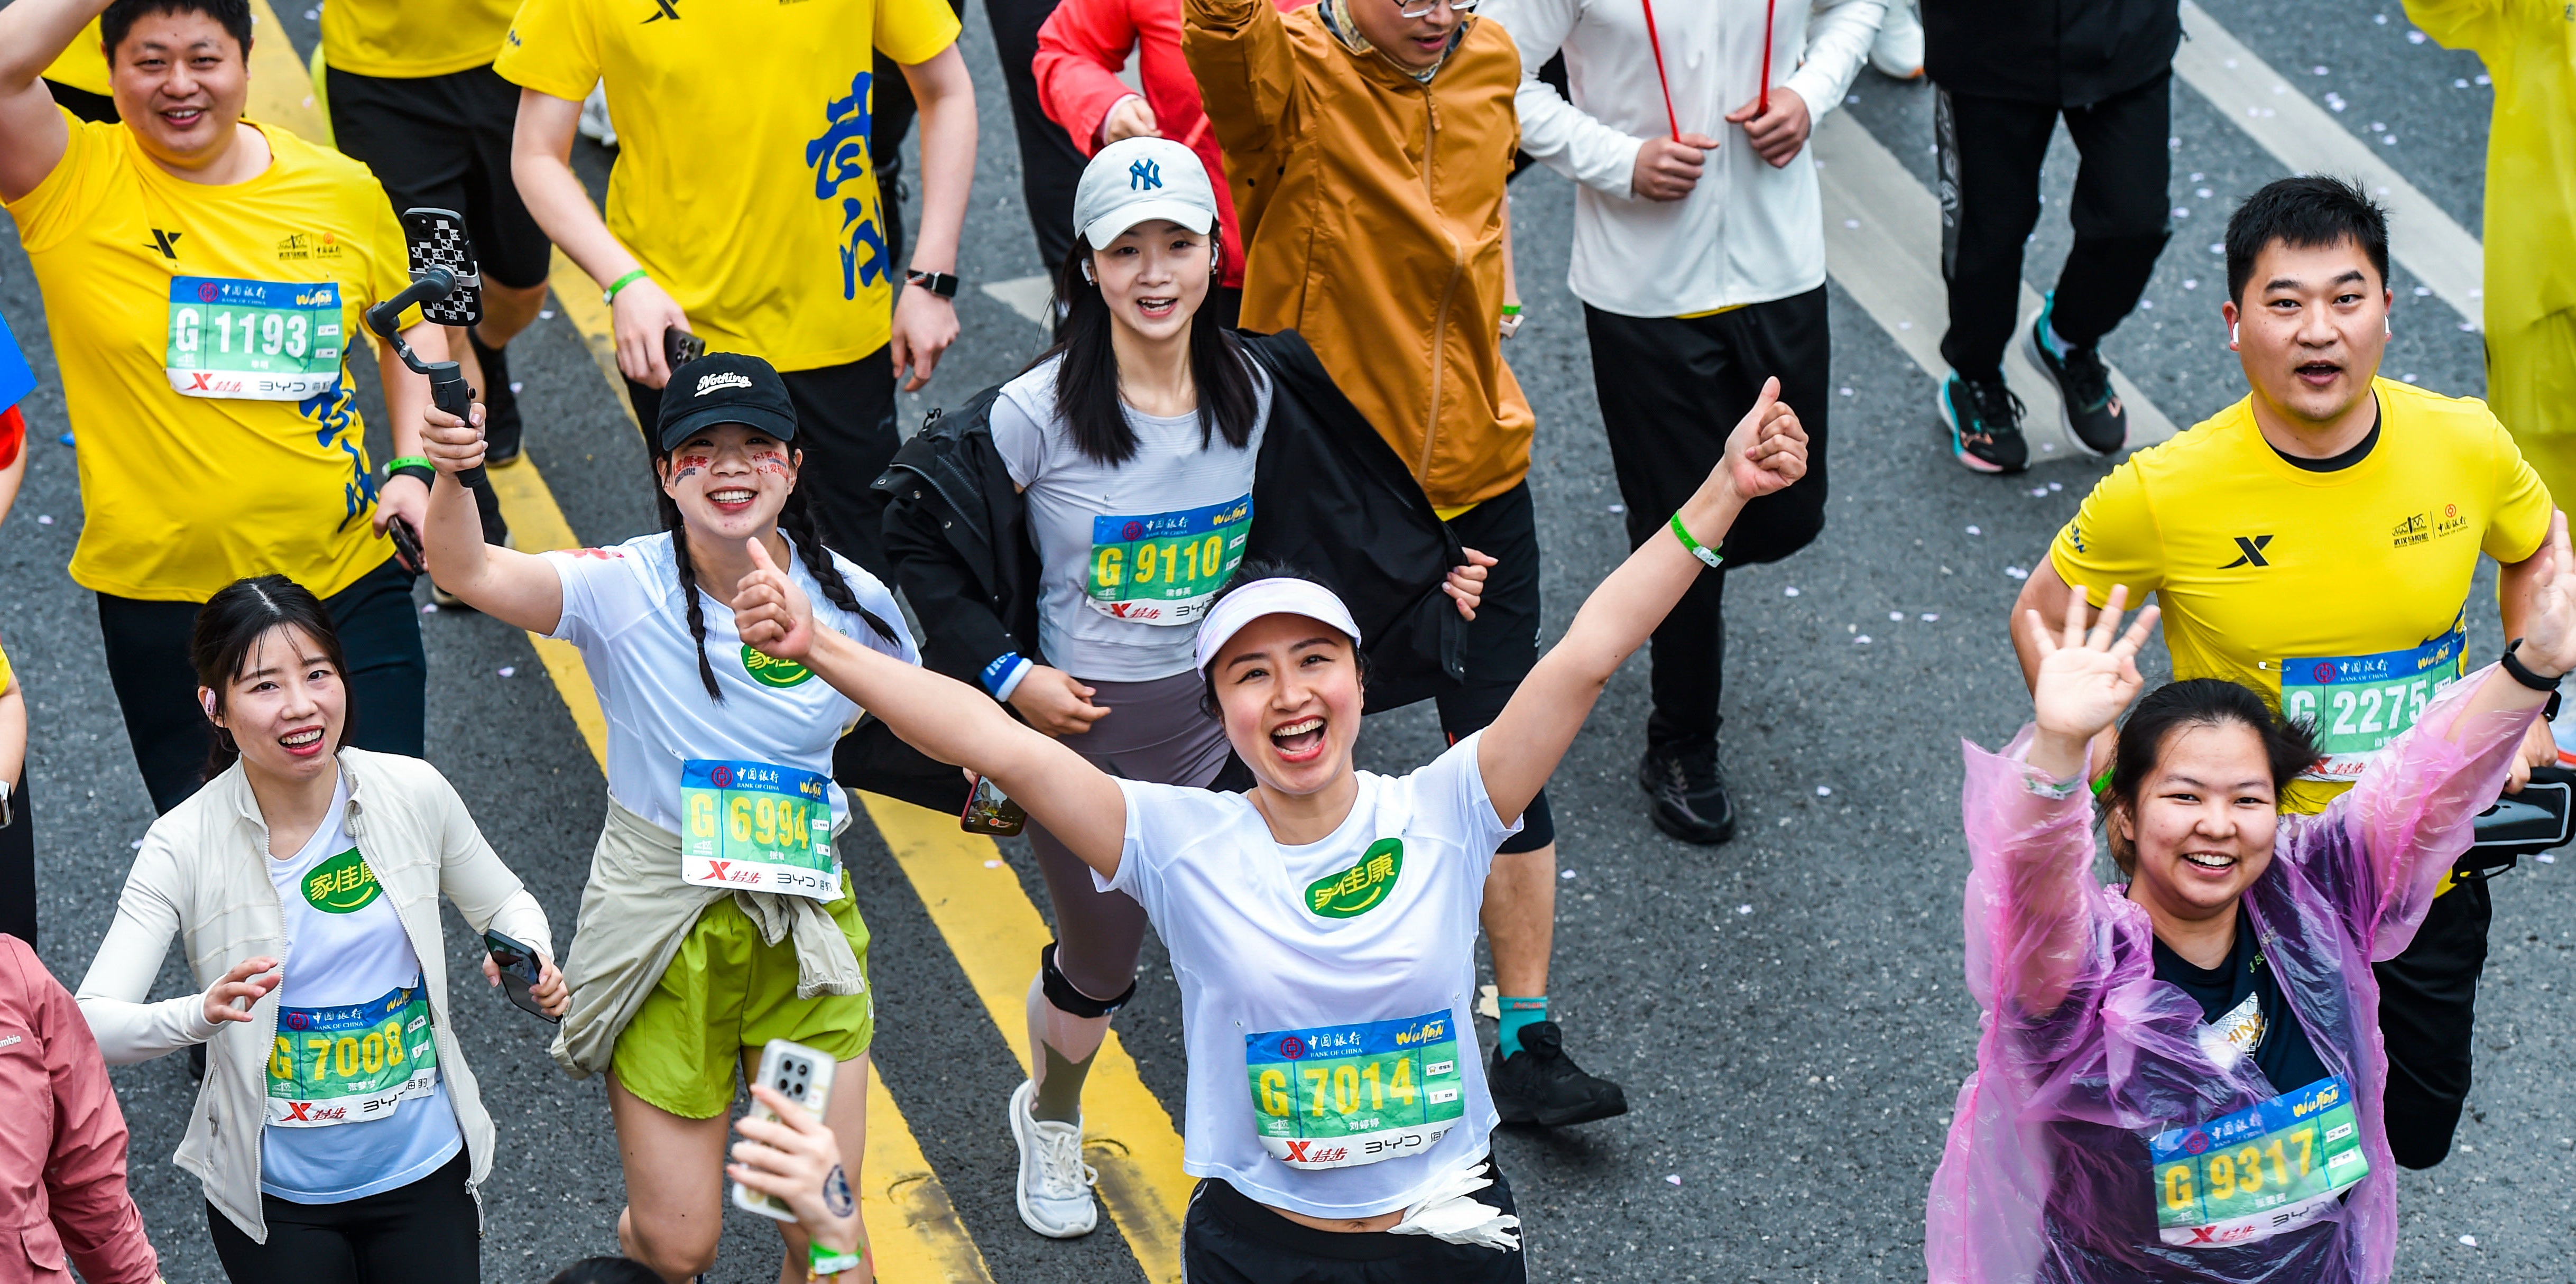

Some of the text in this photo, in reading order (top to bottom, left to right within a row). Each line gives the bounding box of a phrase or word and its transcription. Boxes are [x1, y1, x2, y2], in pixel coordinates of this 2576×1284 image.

[1129, 158, 1162, 191] NY
[176, 308, 307, 358] G 1193
[696, 372, 752, 392] Nothing
[1097, 535, 1223, 587] G 9110
[2333, 680, 2426, 735] 2275
[690, 793, 809, 849] G 6994
[728, 871, 763, 884] 特步
[777, 873, 816, 888] BYD
[1315, 852, 1396, 910] 家佳康
[0, 1034, 21, 1047] mbia
[269, 1022, 404, 1080] G 7008
[1259, 1058, 1415, 1117] G 7014
[310, 1107, 348, 1120] 特步
[1349, 1118, 1380, 1131] 刘婷婷
[1312, 1147, 1349, 1163] 特步
[1365, 1134, 1421, 1154] BYD
[2165, 1128, 2314, 1211] G 9317
